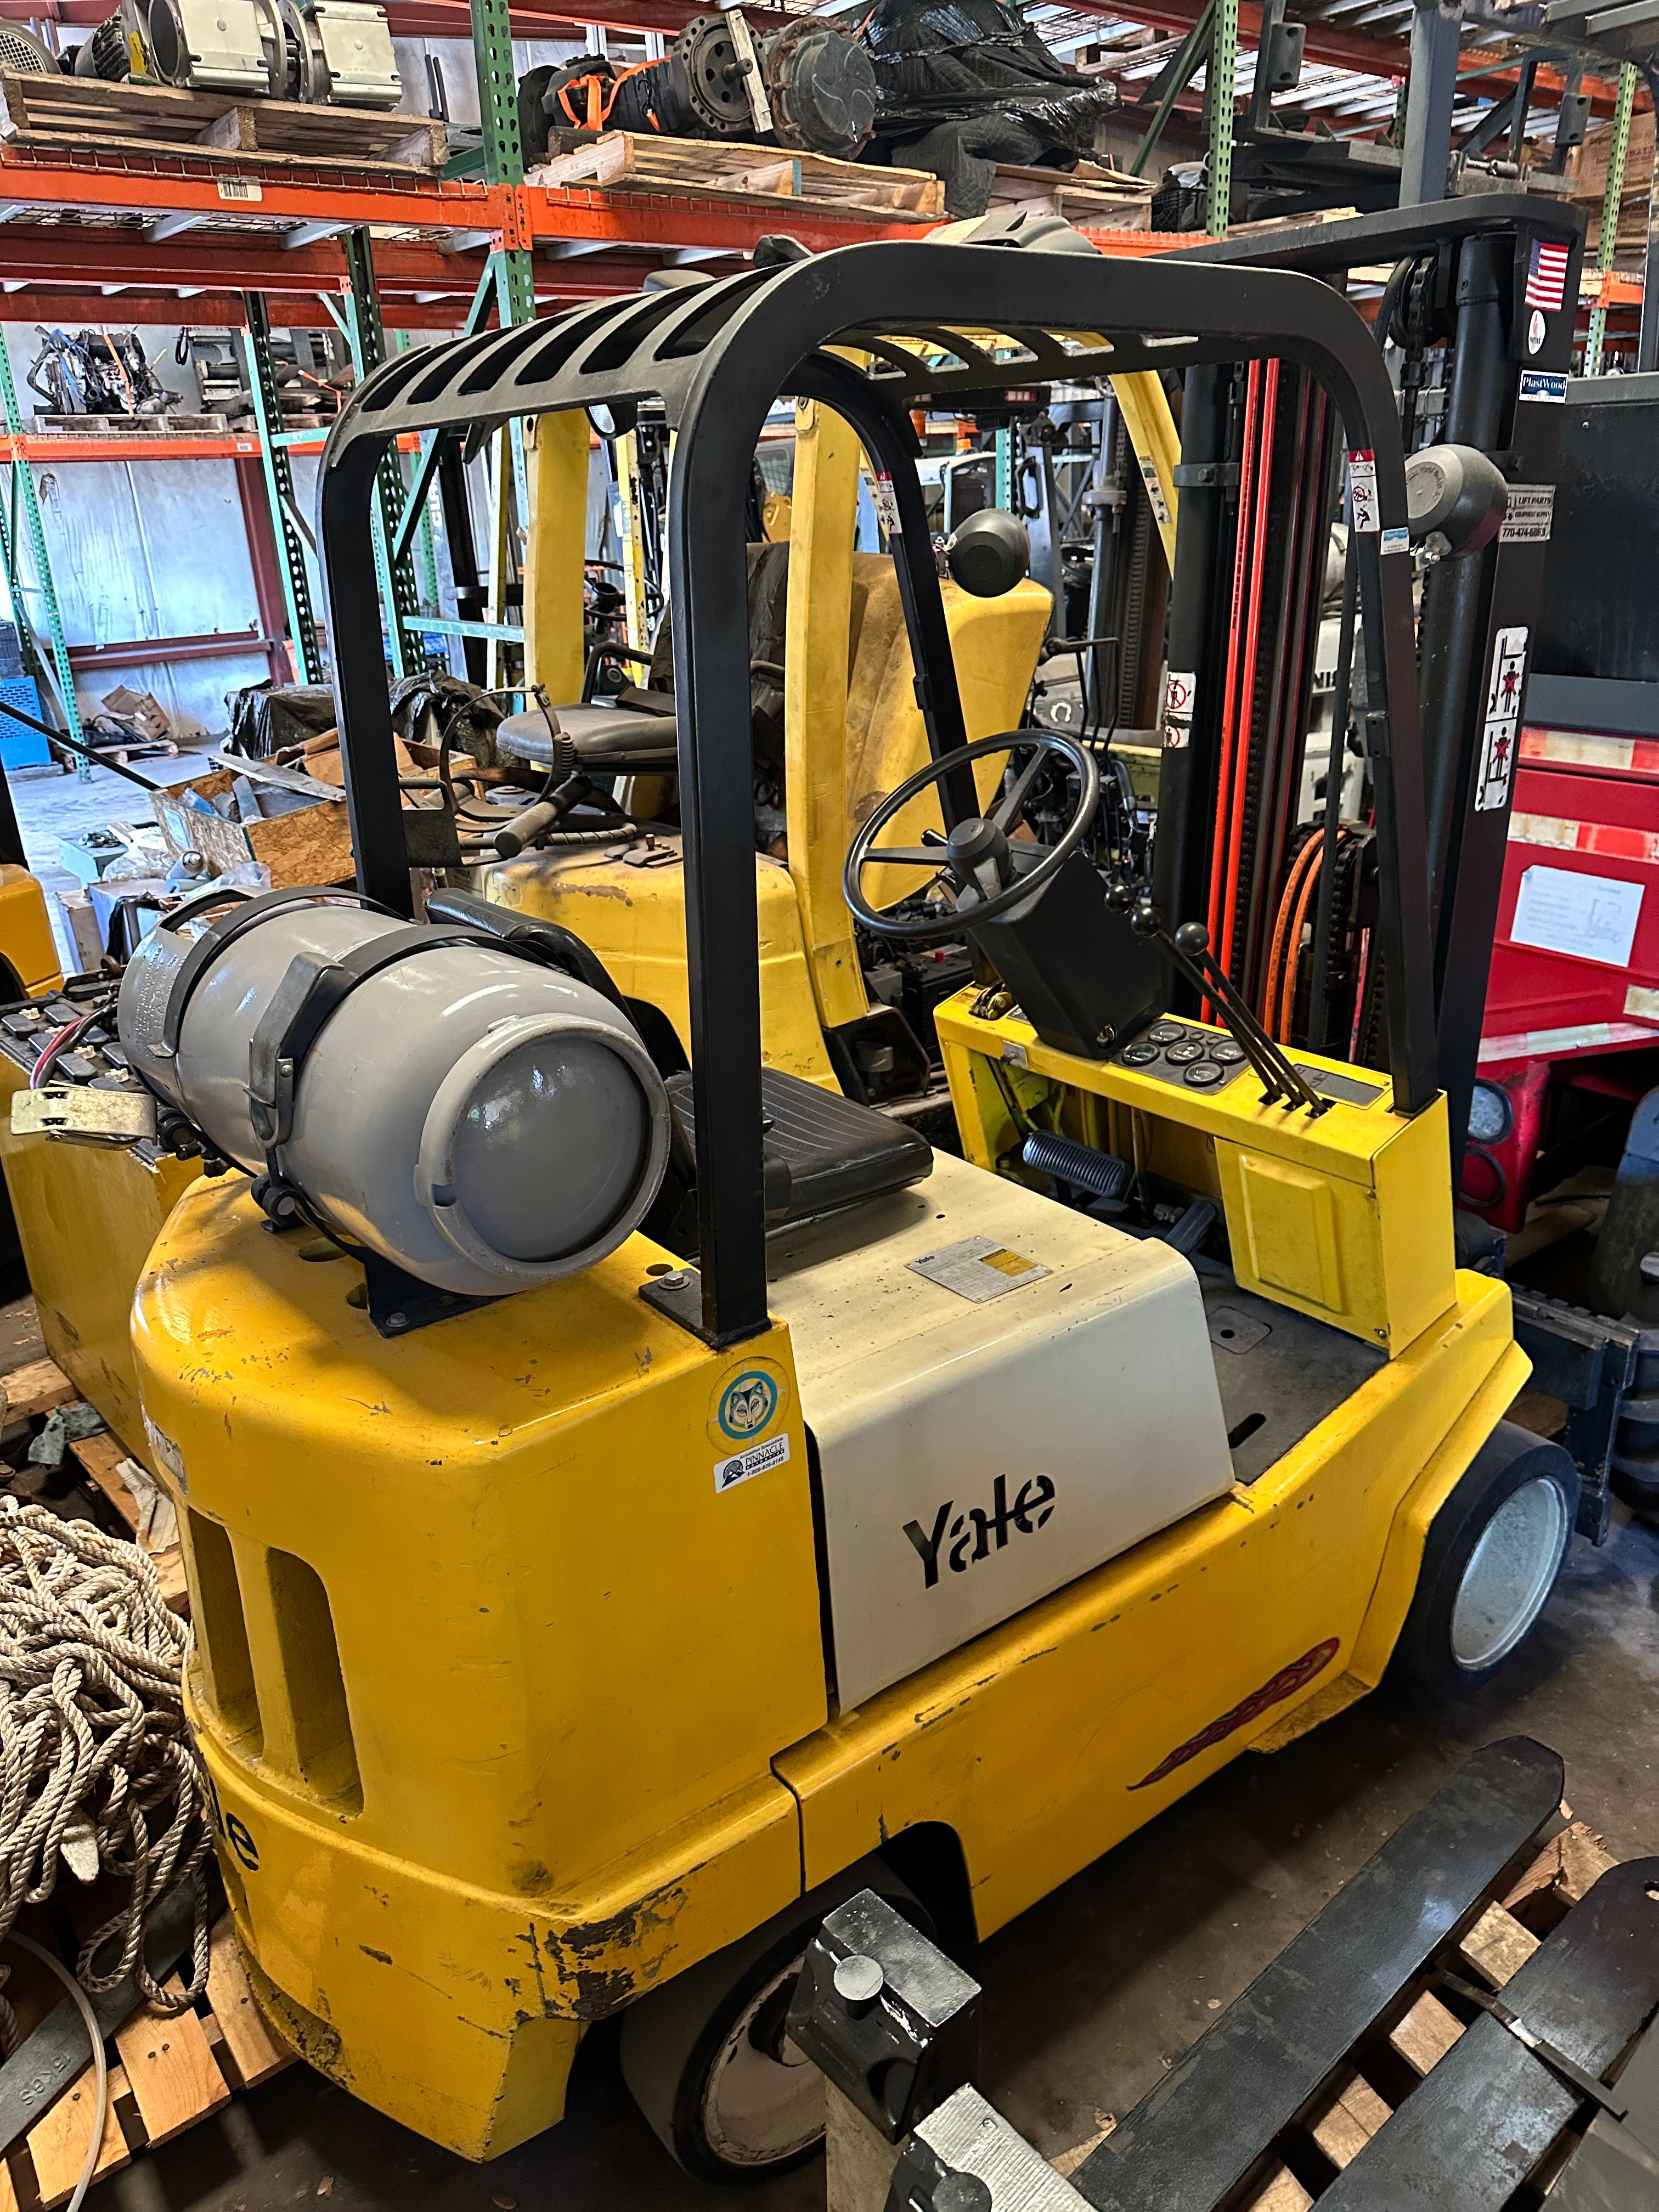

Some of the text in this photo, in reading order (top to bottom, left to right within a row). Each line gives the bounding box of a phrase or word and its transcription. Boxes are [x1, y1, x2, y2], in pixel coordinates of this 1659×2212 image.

[1522, 376, 1566, 390] PlastWood
[746, 1442, 783, 1465] PINNACLE
[902, 1474, 1055, 1589] Yale
